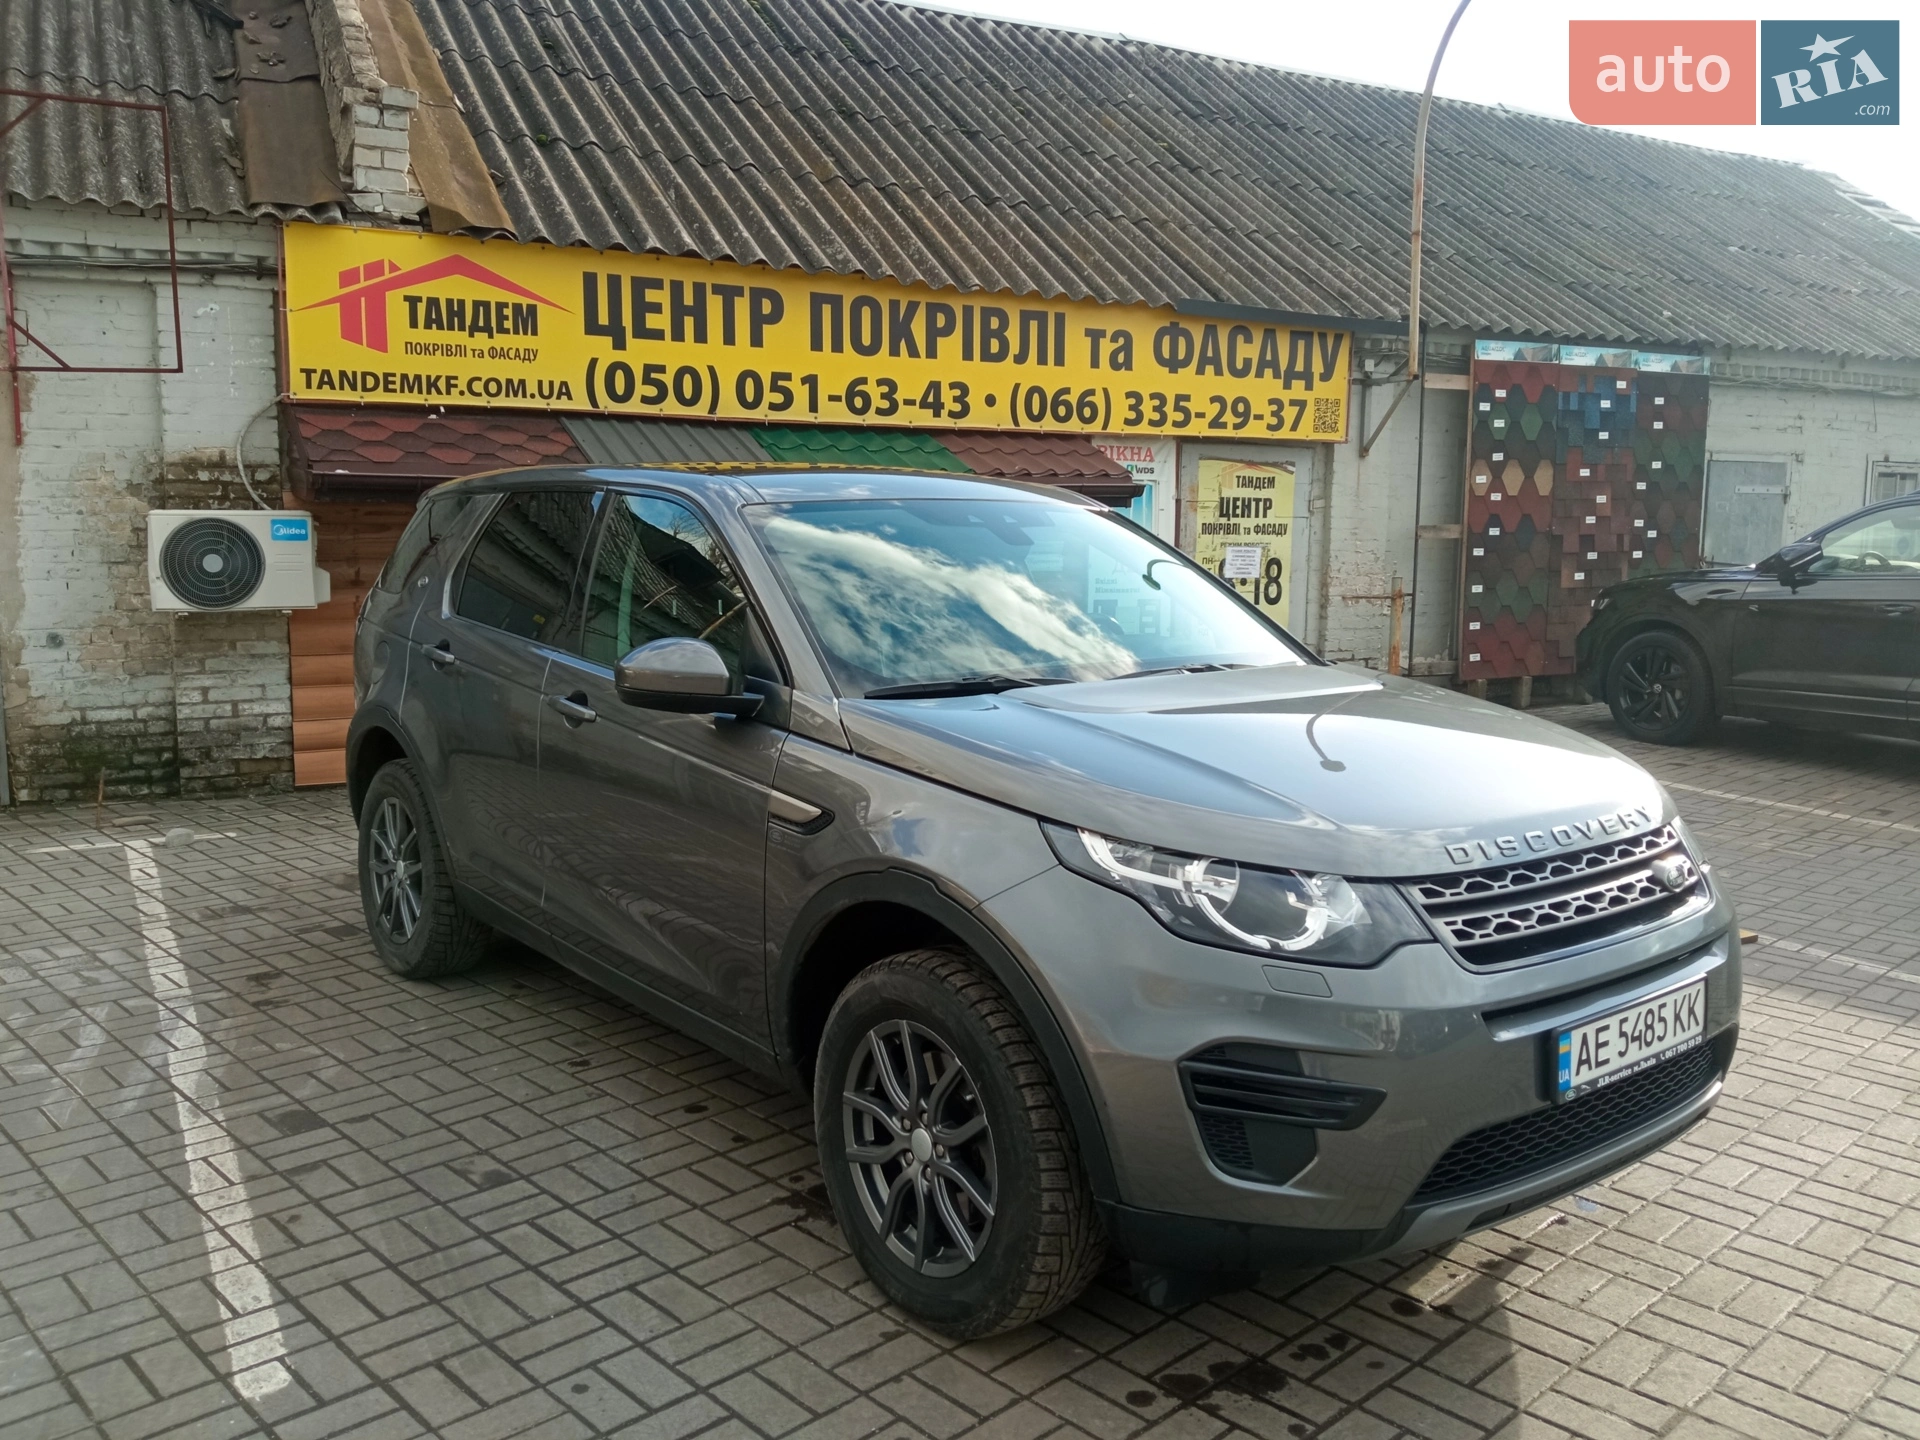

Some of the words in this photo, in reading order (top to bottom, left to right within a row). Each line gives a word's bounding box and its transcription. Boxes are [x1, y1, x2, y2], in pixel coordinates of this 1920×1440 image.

[403, 294, 539, 338] ТАНДЕМ
[582, 270, 785, 352] ЦЕНТР
[808, 291, 1067, 368] ПОКРІВЛІ
[1084, 327, 1134, 372] та
[1153, 321, 1344, 391] ФАСАДУ
[404, 341, 467, 360] ПОКРІВЛІ
[471, 350, 485, 361] та
[487, 345, 539, 364] ФАСАДУ
[300, 367, 573, 401] TANDEMKF.COM.UA
[585, 356, 720, 415] (050)
[735, 368, 971, 420] 051-63-43
[1010, 381, 1113, 430] (066)
[1123, 393, 1308, 433] 335-29-37
[1135, 465, 1155, 474] WDS
[1235, 475, 1275, 491] ТАНДЕМ
[1219, 496, 1273, 520] ЦЕНТР
[273, 524, 306, 536] Midea
[1201, 522, 1241, 536] ПОКРІВЛІ
[1243, 527, 1251, 536] та
[1253, 523, 1288, 537] ФАСАДУ
[1445, 805, 1654, 866] DISCOVERY
[1574, 1024, 1611, 1077] AE
[1617, 1010, 1668, 1059] 5485
[1672, 988, 1702, 1038] KK
[1559, 1068, 1571, 1083] UA
[1597, 1068, 1632, 1088] JLR-service
[1665, 1048, 1677, 1059] 067
[1677, 1043, 1688, 1054] 700
